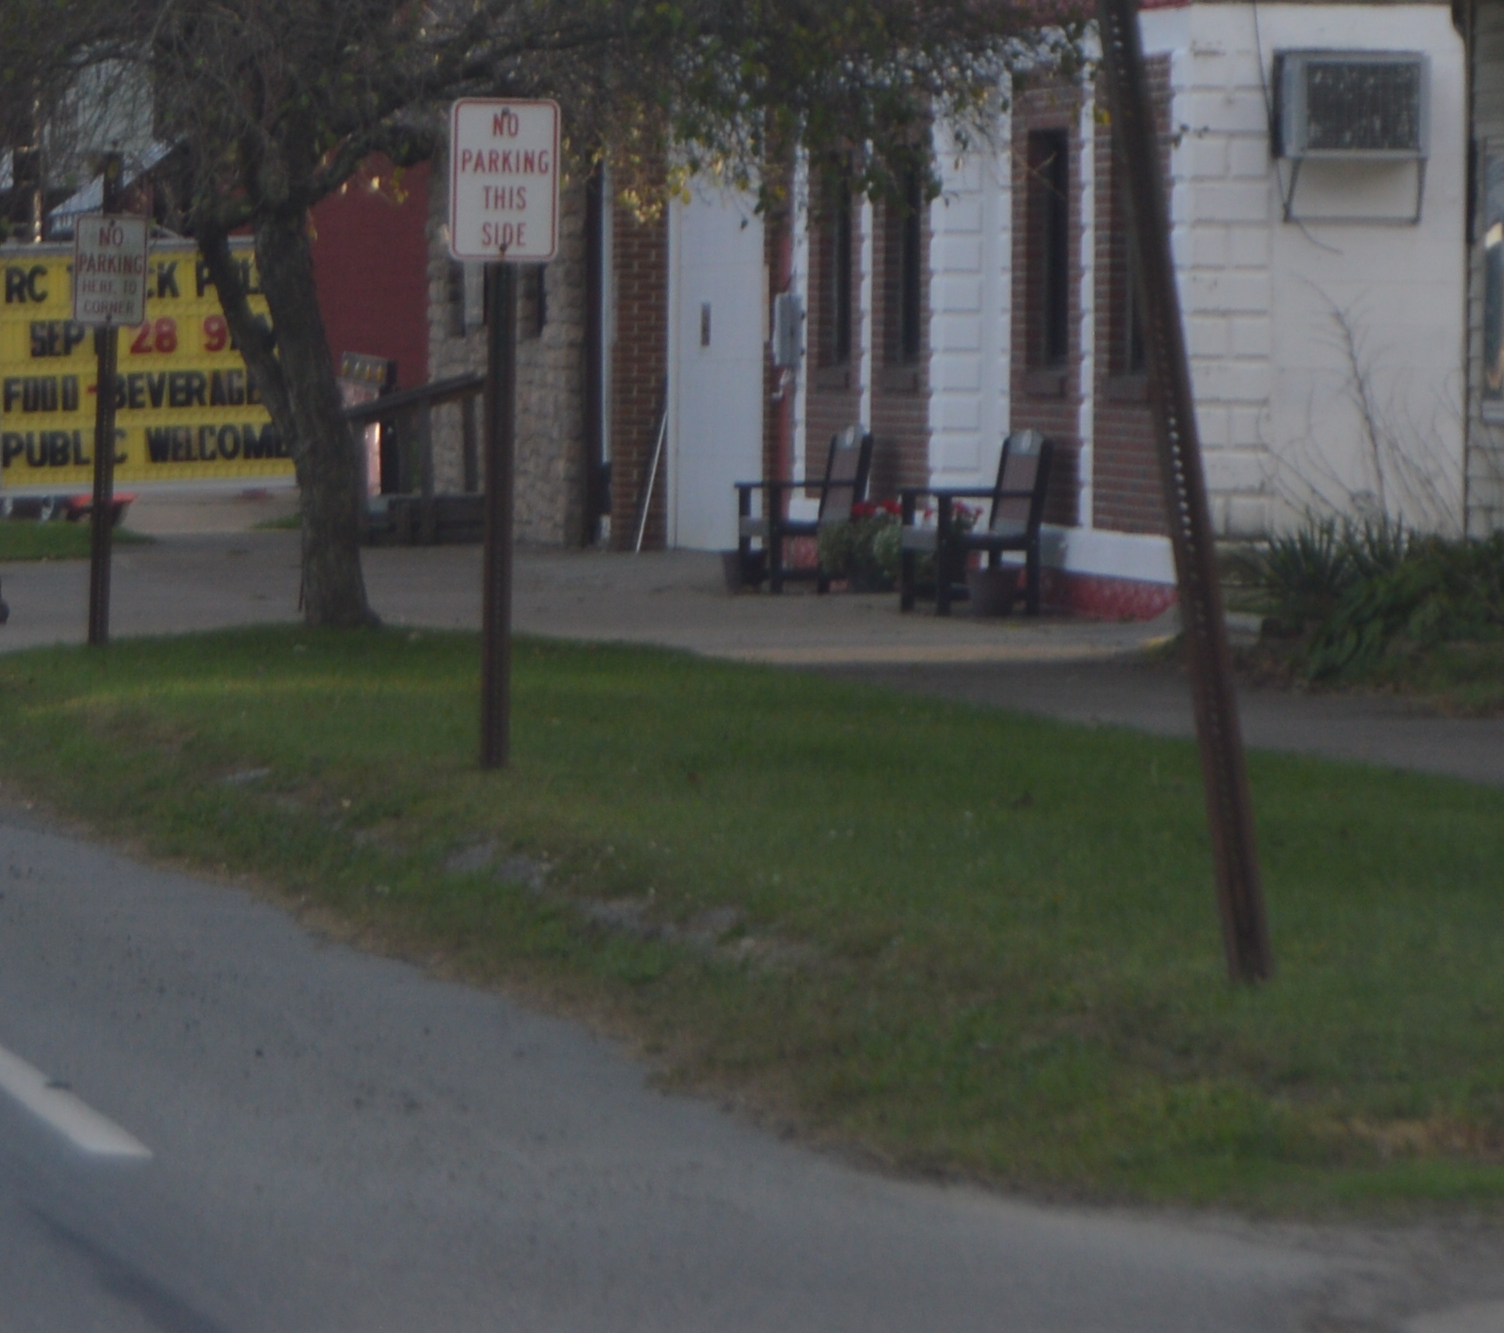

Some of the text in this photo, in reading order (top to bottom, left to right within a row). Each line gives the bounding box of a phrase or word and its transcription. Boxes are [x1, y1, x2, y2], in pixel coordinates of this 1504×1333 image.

[493, 113, 519, 137] NO
[461, 149, 550, 174] PARKING
[483, 186, 527, 210] THIS
[98, 226, 124, 247] NO
[481, 222, 527, 247] SIDE
[79, 253, 143, 275] PARKING
[4, 264, 48, 303] RC
[82, 277, 117, 296] HERE
[83, 300, 135, 315] CORNER
[129, 315, 179, 354] 28
[4, 373, 80, 413] FOOD
[2, 429, 128, 468] PUBLC
